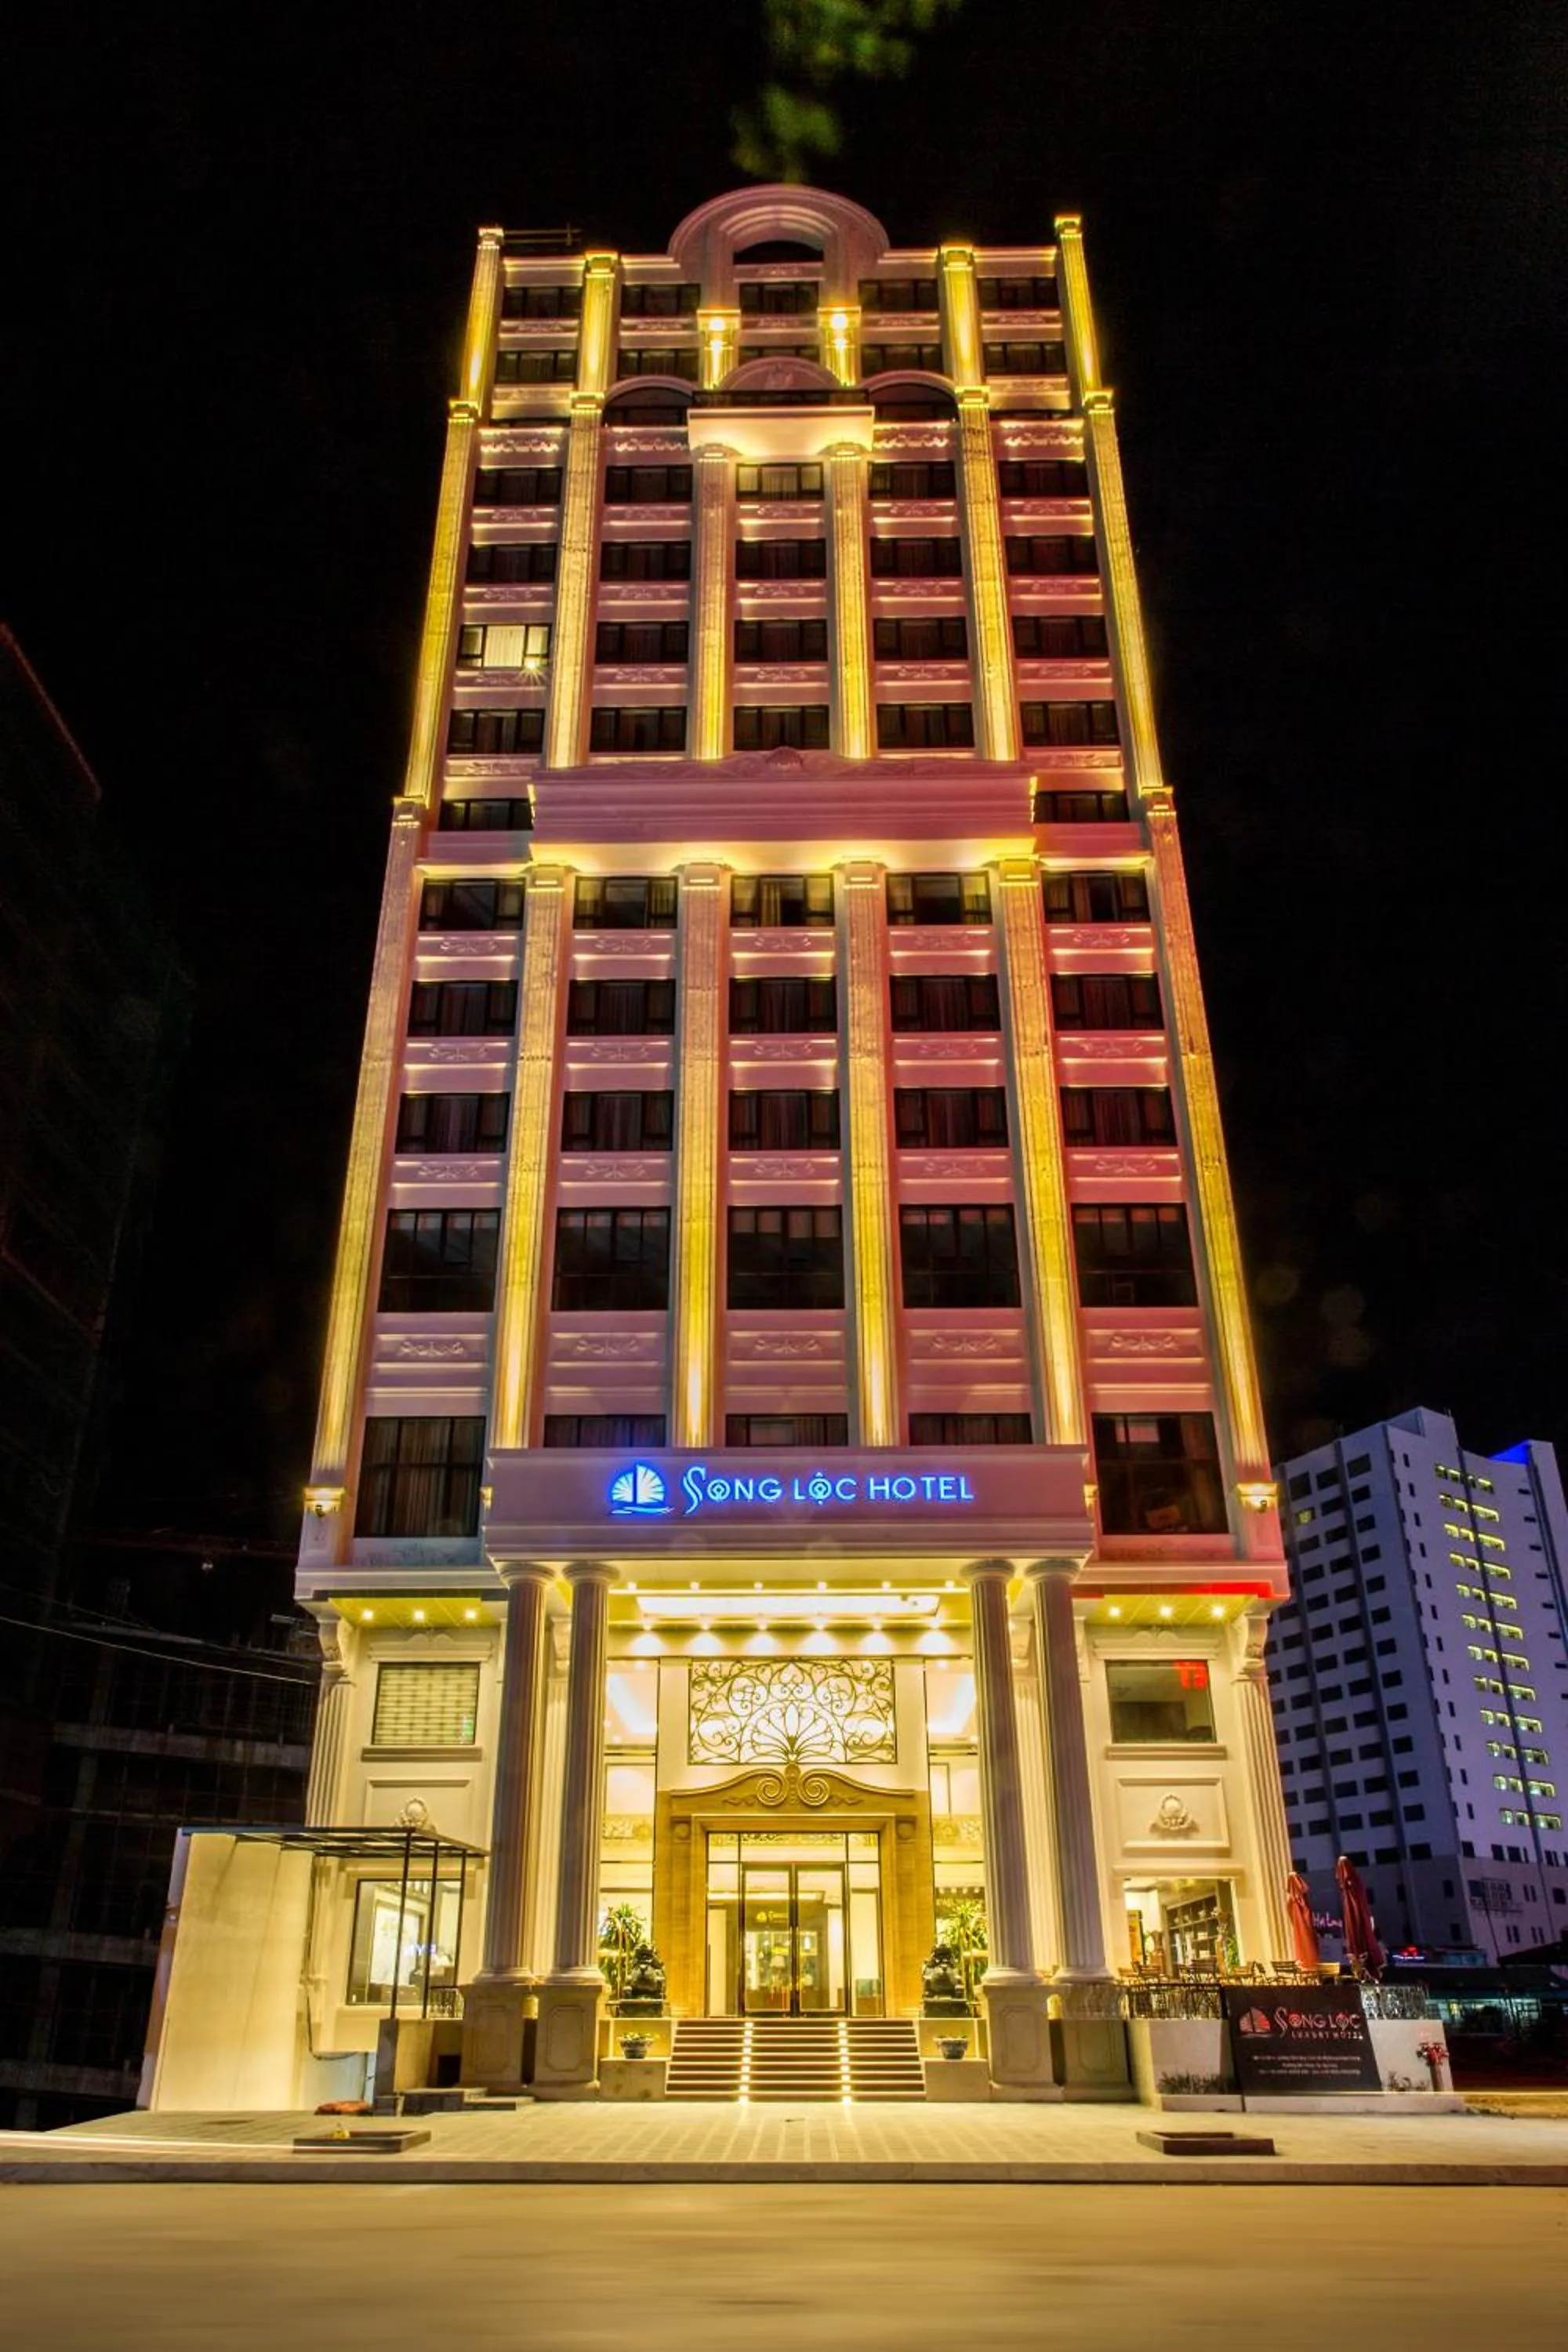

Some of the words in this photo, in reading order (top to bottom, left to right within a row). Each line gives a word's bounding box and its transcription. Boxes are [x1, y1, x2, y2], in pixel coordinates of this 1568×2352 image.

[683, 1465, 782, 1516] SONG
[869, 1476, 975, 1501] HOTEL
[1274, 2006, 1326, 2038] SONG
